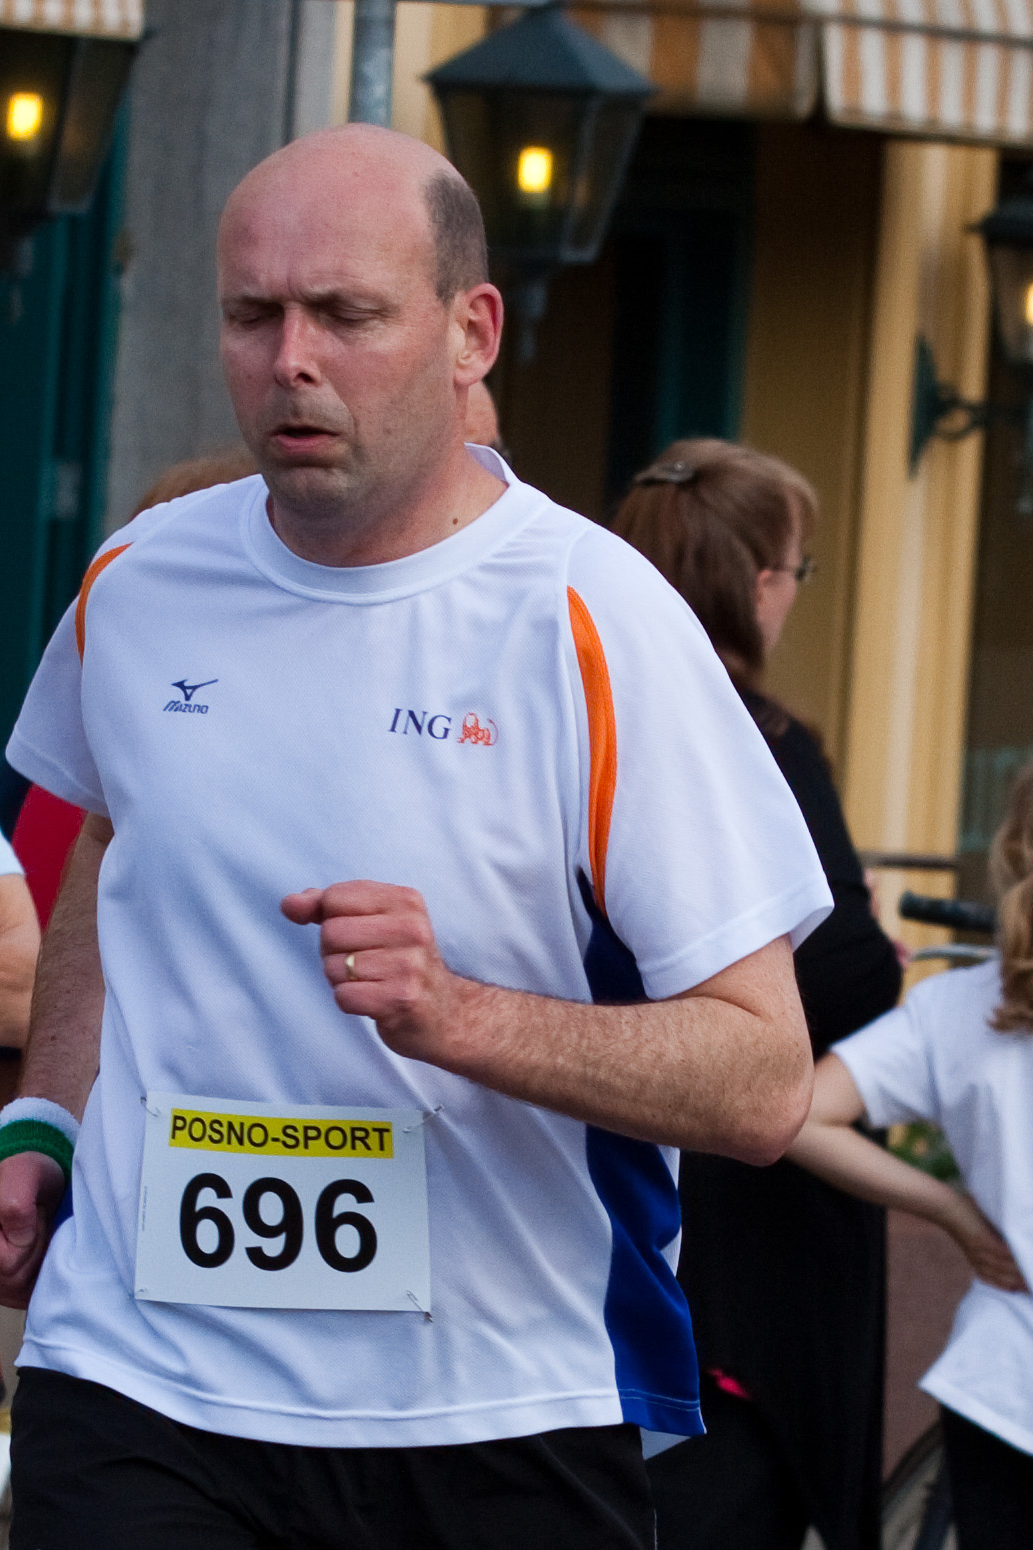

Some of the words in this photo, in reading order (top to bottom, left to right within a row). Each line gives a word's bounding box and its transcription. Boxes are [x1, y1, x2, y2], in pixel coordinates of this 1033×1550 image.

[389, 708, 452, 739] ING
[171, 1115, 390, 1151] POSNO-SPORT
[179, 1172, 378, 1273] 696
